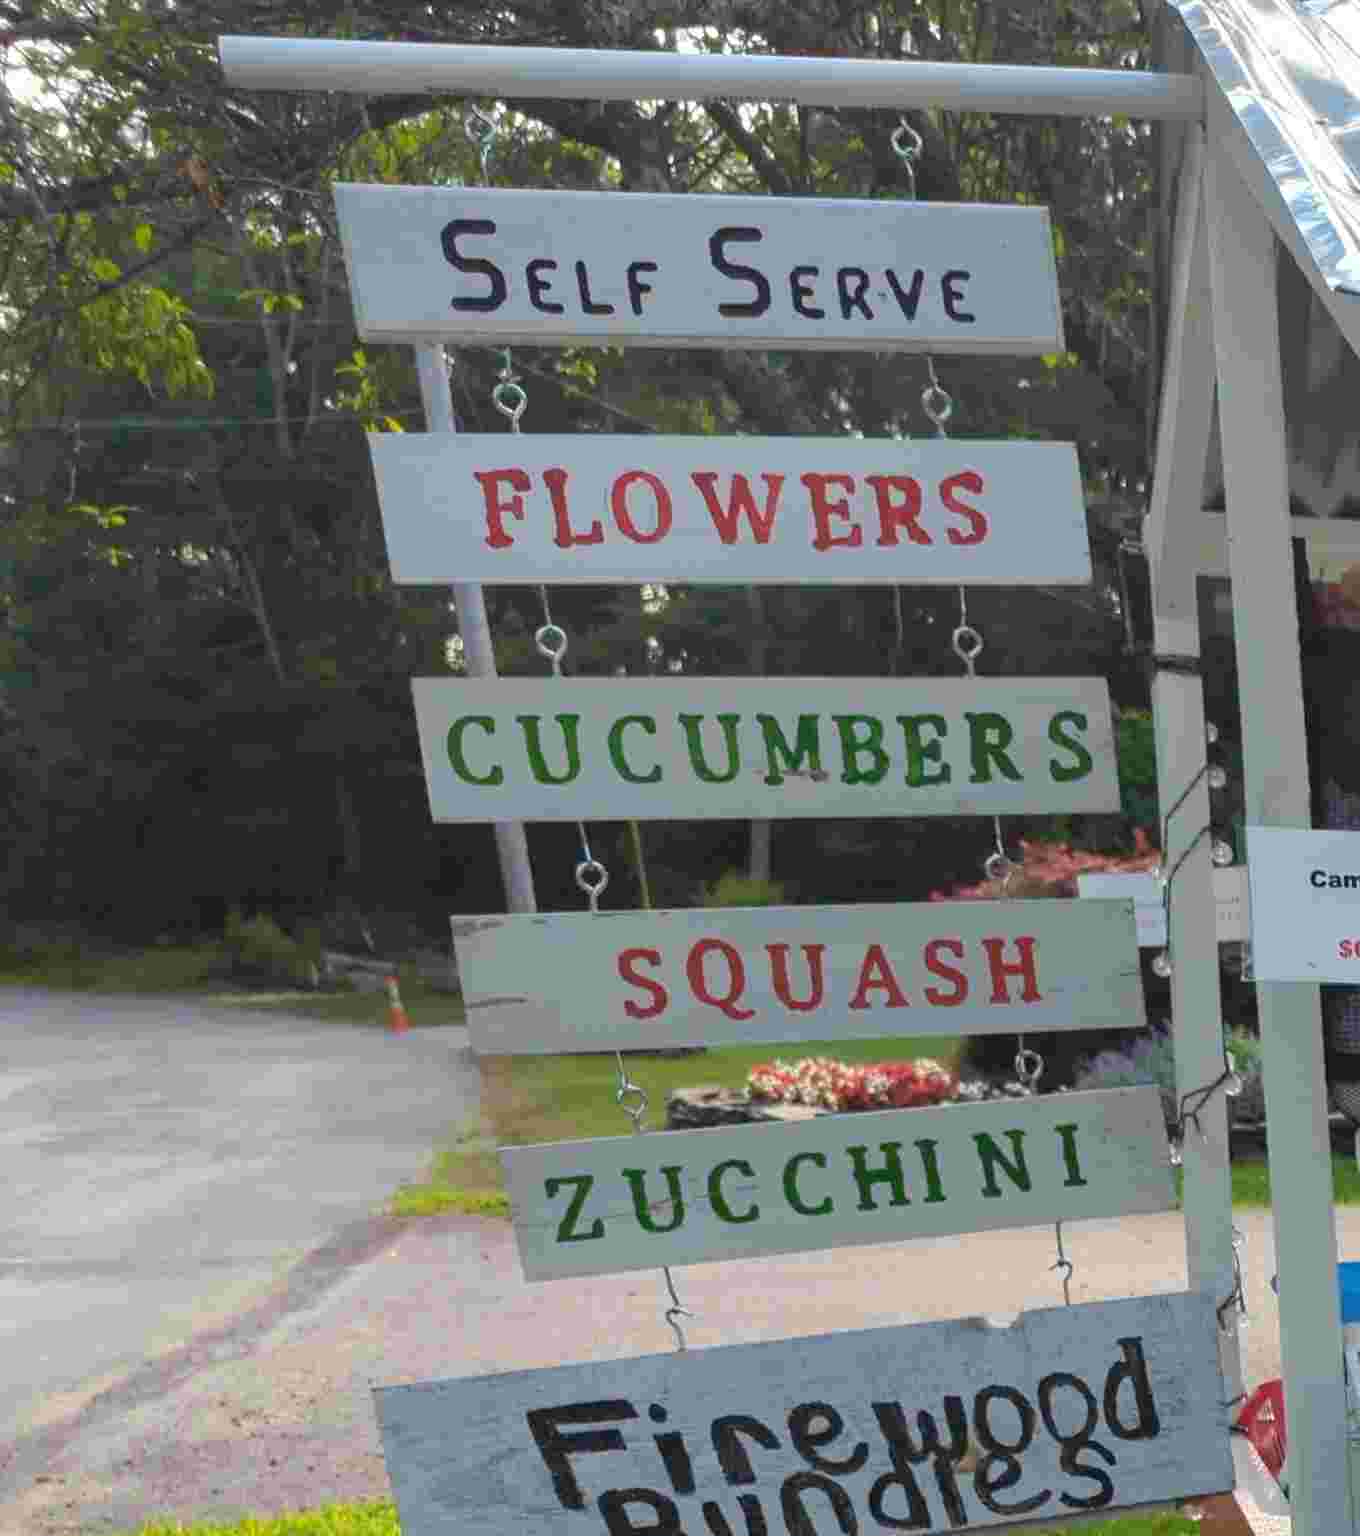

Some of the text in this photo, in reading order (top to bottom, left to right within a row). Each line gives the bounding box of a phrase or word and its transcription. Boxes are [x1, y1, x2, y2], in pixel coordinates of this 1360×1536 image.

[440, 219, 977, 325] SELF SERVE
[473, 466, 991, 550] FLOWERS
[446, 710, 1094, 787] CUCUMBERS
[616, 935, 1042, 1020] SQUASH
[545, 1122, 1088, 1244] ZUCCHINI
[526, 1336, 1161, 1511] Firewood
